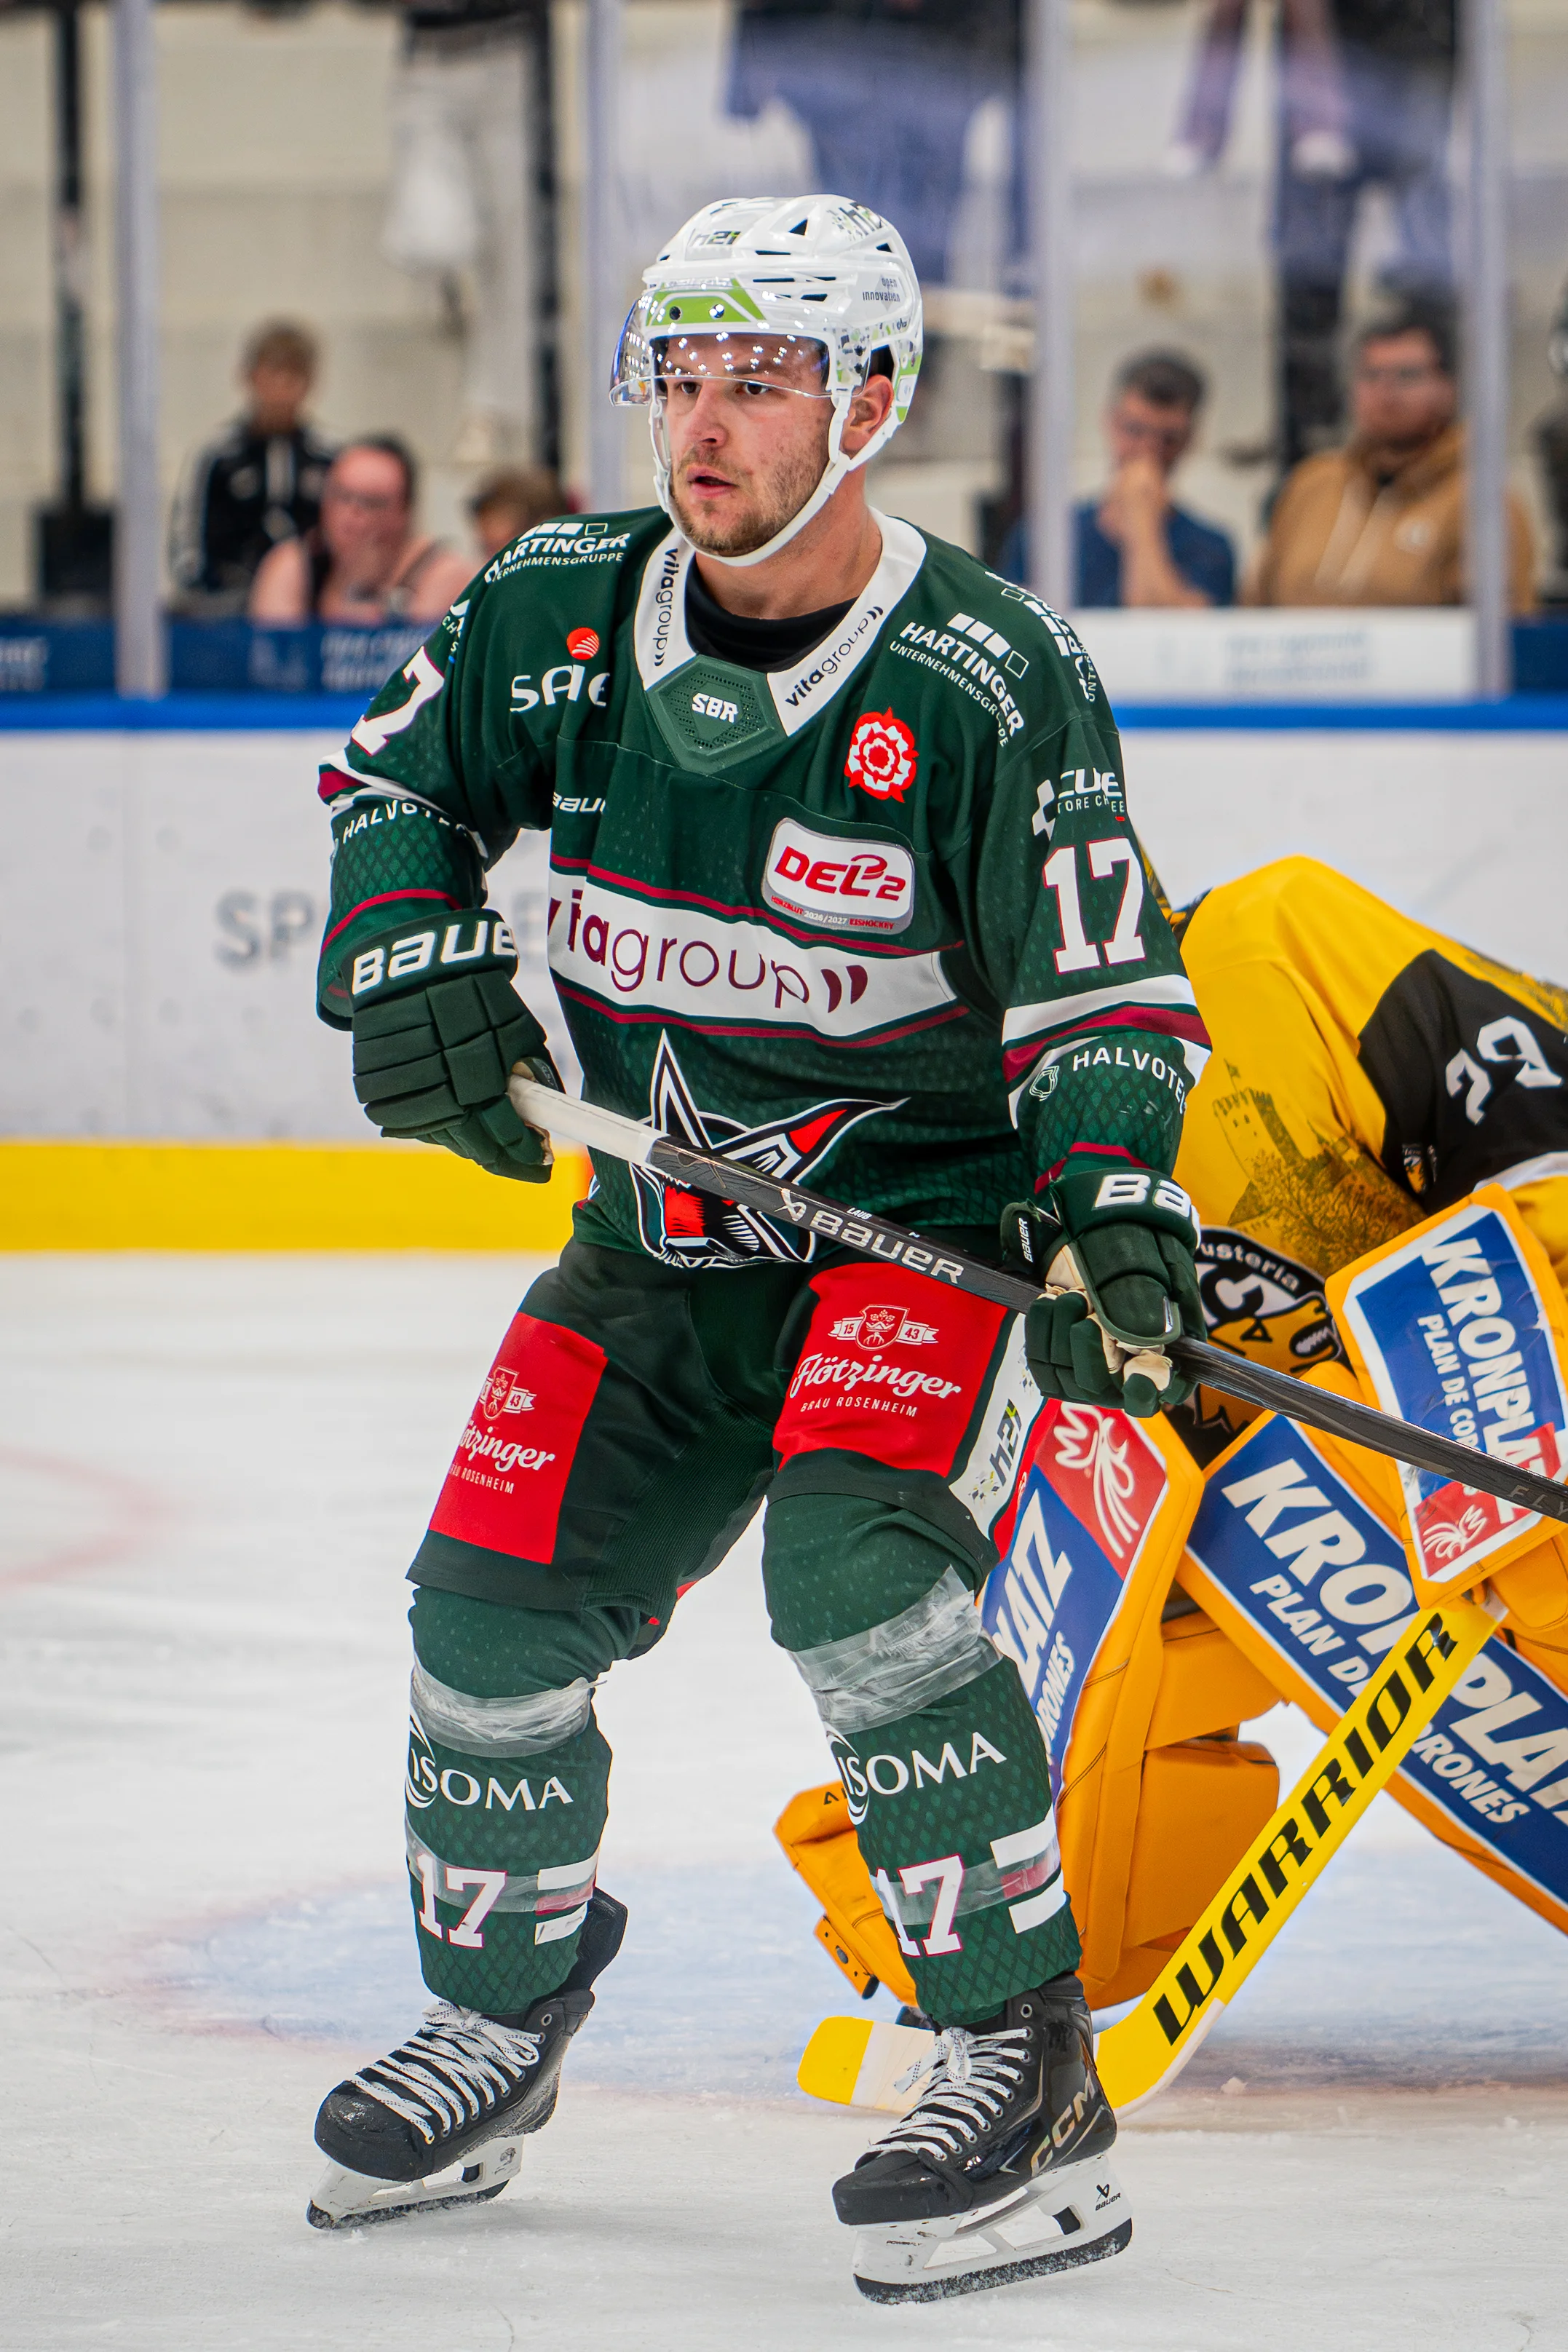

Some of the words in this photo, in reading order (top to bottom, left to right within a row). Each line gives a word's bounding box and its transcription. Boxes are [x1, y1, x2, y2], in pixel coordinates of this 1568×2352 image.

[862, 290, 900, 302] innovation
[881, 277, 898, 288] open
[653, 547, 679, 651] vitagroup
[351, 646, 446, 758] 7
[785, 617, 869, 708] vitagroup
[899, 622, 1025, 737] HARTINGER
[692, 692, 738, 724] SBR
[1043, 836, 1147, 975] 17
[809, 1208, 965, 1286] BAUER
[846, 1207, 873, 1220] LAUB
[1018, 1217, 1034, 1263] BAUER
[789, 1353, 962, 1399] Flötzinger
[1417, 1314, 1462, 1375] PLAN
[1441, 1376, 1470, 1406] DE
[836, 1396, 918, 1417] ROSENHEIM
[461, 1467, 515, 1494] ROSENHEIM
[1248, 1572, 1345, 1657] PLAN
[1152, 1612, 1460, 2046] WARRIOR
[415, 1852, 509, 1949] 17
[874, 1853, 965, 1958] 17
[1031, 2069, 1096, 2179] CCM
[1095, 2192, 1122, 2212] BAUER
